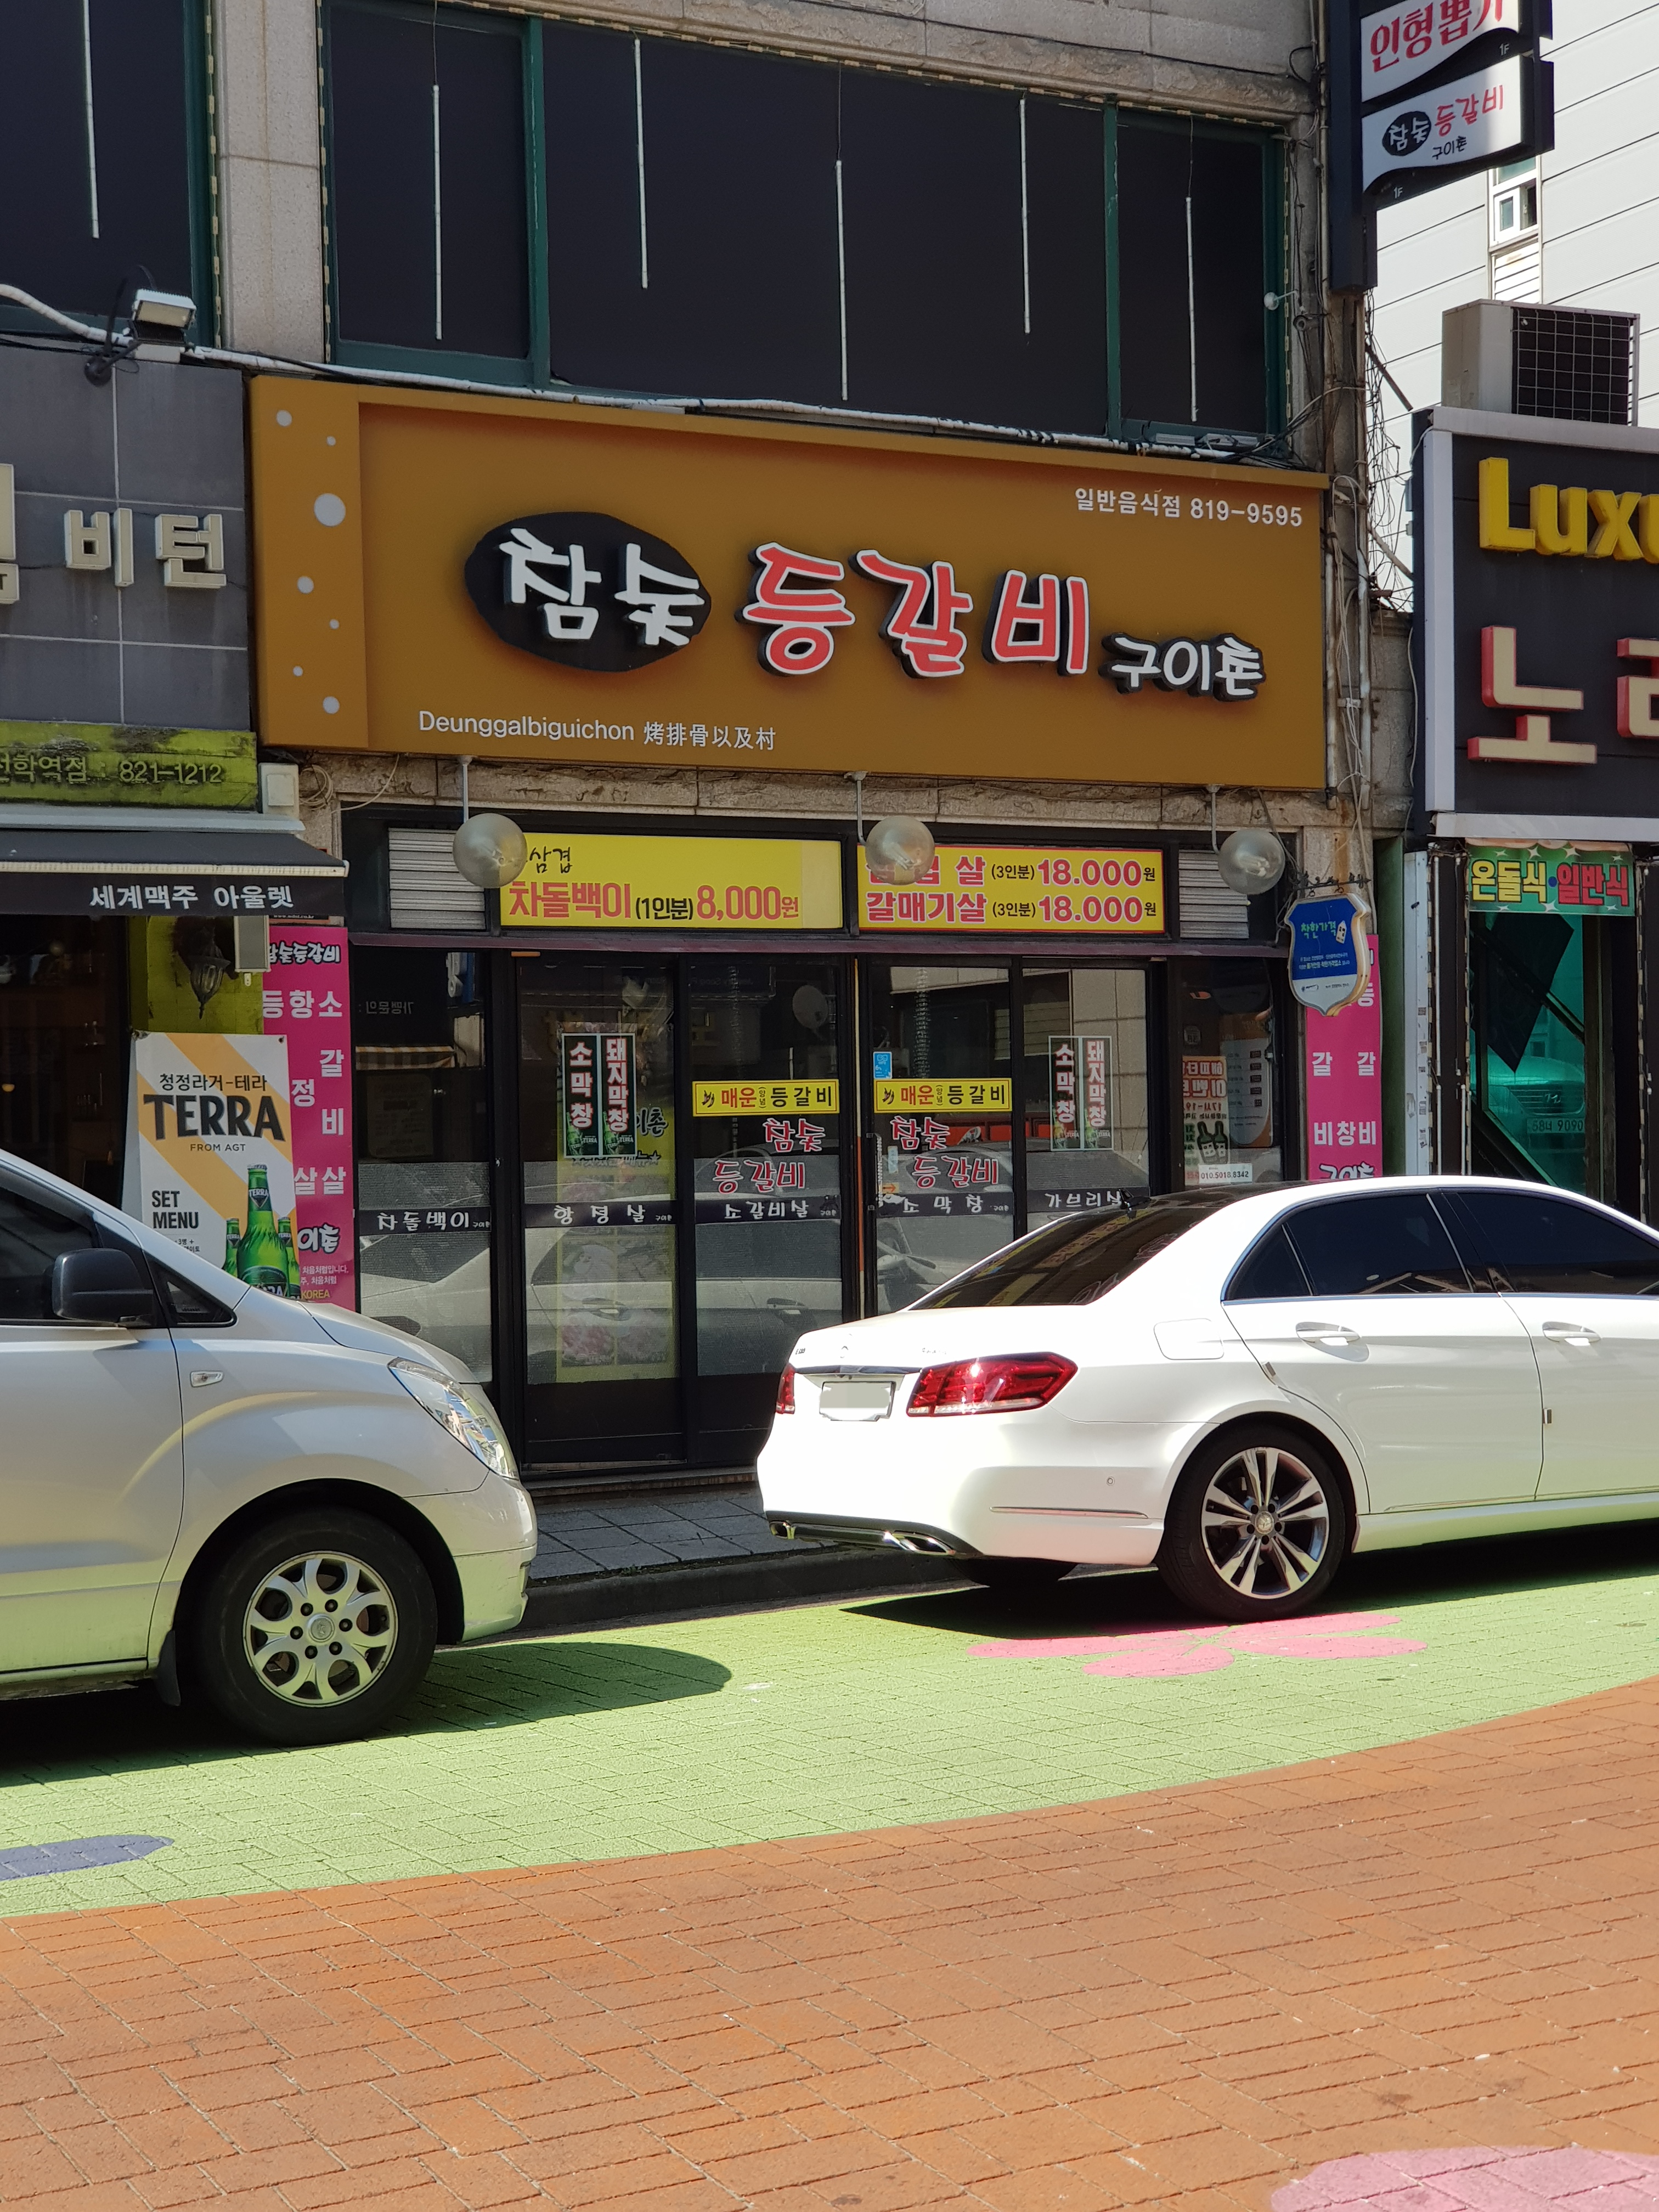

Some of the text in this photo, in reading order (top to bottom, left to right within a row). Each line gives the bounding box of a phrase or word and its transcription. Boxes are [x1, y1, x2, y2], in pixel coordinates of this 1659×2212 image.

[1499, 43, 1510, 55] 1F
[1434, 84, 1503, 137] 등갈비
[1393, 186, 1403, 199] 1F
[1075, 487, 1304, 527] 일반음식점 819-9595
[738, 541, 1090, 679] 등갈비
[1101, 634, 1263, 701] 구이촌
[419, 710, 776, 751] Deunggalbiguichon 烤排骨以及村
[119, 760, 222, 785] 821-1212
[991, 864, 1035, 881] (3인분)
[89, 884, 294, 910] 세계맥주 아울렛
[509, 880, 631, 919] 차돌백이
[635, 896, 694, 921] (1인분)
[866, 891, 988, 924] 갈매기살
[992, 901, 1036, 918] (3인분)
[159, 1073, 268, 1092] 청정라거-테라
[569, 1041, 594, 1129] 소막창
[606, 1037, 629, 1134] 돼지막창
[900, 1085, 935, 1106] 매운
[946, 1084, 1005, 1105] 등갈비
[1055, 1043, 1076, 1124] 소막창
[1086, 1040, 1107, 1129] 돼지막창
[721, 1086, 757, 1108] 매운
[770, 1085, 832, 1108] 등갈비
[143, 1094, 286, 1142] TERRA
[190, 1143, 246, 1152] FROM AGT
[713, 1159, 805, 1194] 등갈비
[912, 1154, 999, 1189] 등갈비
[151, 1190, 180, 1207] SET
[249, 1188, 269, 1198] TERRA
[153, 1211, 200, 1229] MENU
[377, 1211, 470, 1232] 차돌백이
[724, 1199, 809, 1220] 소갈비살
